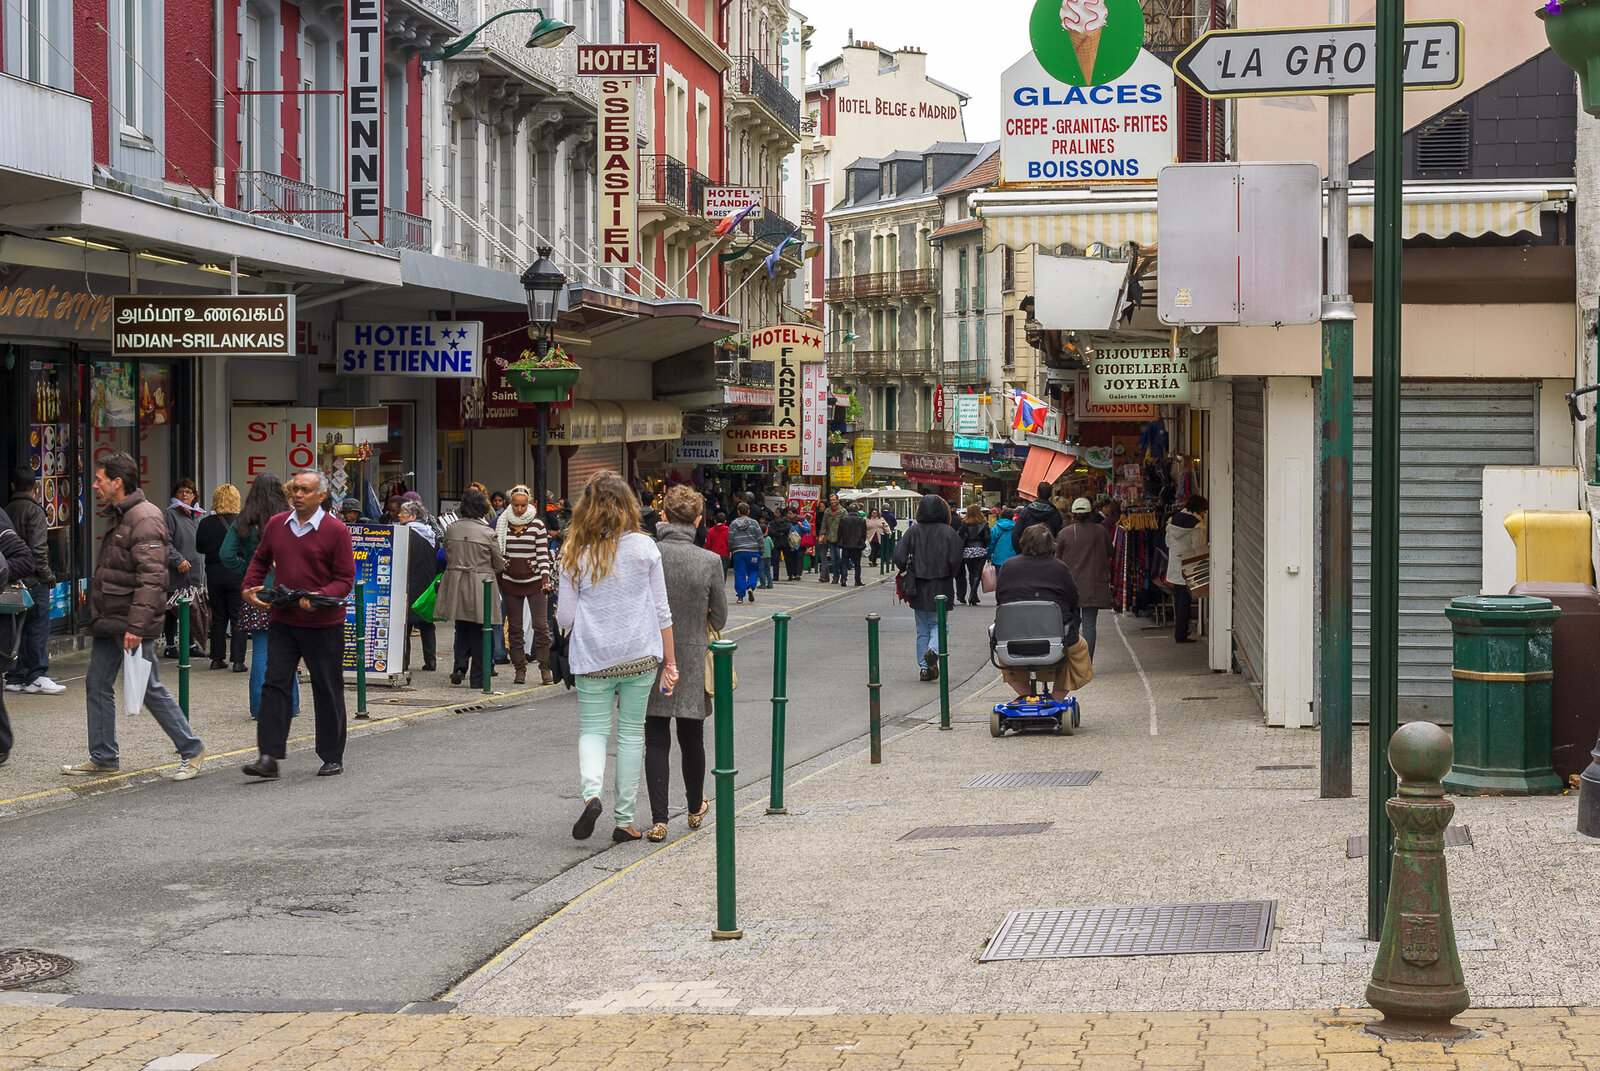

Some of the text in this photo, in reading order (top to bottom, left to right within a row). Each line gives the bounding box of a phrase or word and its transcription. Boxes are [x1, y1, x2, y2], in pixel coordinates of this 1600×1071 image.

[579, 49, 649, 71] HOTEL
[1220, 39, 1442, 79] LA GROTE
[602, 80, 632, 94] ST
[1013, 83, 1163, 106] GLACES
[838, 97, 957, 120] HOTEL BELGE & MADRID
[1006, 116, 1048, 136] CREPE
[1124, 114, 1168, 133] FRITES
[1052, 138, 1114, 155] PRALINES
[1028, 159, 1139, 178] BOISSONS
[603, 97, 631, 264] SEBASTIEN
[708, 189, 749, 198] HOTEL
[117, 302, 284, 325] அம்மா உணவகம்
[117, 333, 285, 349] INDIAN-SRILANKAIS
[354, 325, 436, 347] HOTEL
[752, 329, 800, 349] HOTEL
[343, 349, 472, 372] St ETIENNE
[1095, 347, 1188, 360] BIJOUTERE
[1095, 363, 1188, 375] GIOIELLERIA
[778, 347, 796, 427] FLANDRIA
[1103, 375, 1180, 390] JOYERÍA
[491, 391, 518, 400] Saint
[248, 422, 279, 443] ST
[726, 429, 796, 440] CHAMBRES
[682, 438, 714, 447] Souvenirs
[737, 443, 788, 453] LIBRES
[676, 448, 719, 459] L'ESTELLAT
